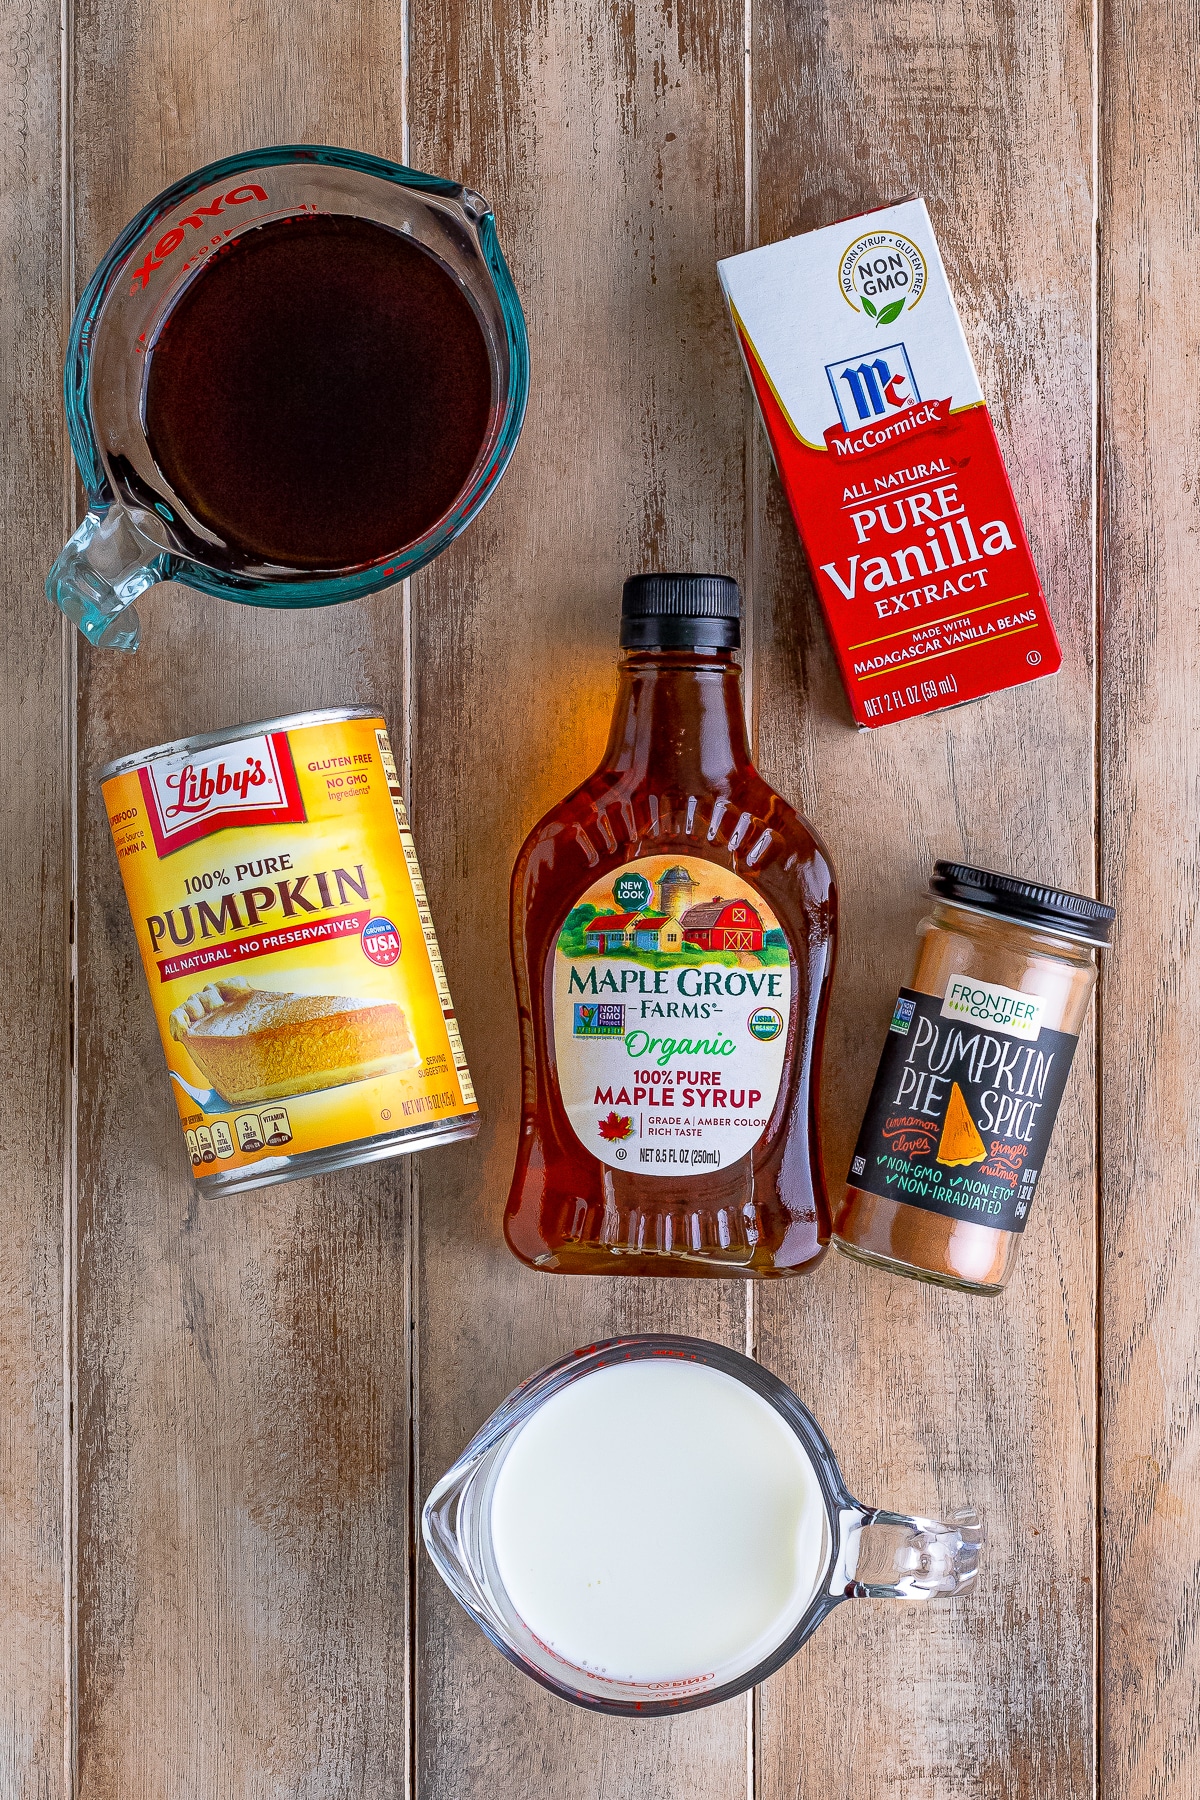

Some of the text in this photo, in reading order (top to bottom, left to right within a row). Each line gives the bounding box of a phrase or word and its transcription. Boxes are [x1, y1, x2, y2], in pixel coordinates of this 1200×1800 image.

[843, 236, 923, 295] NO CORN SYRUP GLUTEN FREE
[858, 253, 903, 280] NON
[863, 271, 908, 296] GMO
[831, 403, 941, 456] McCormick
[842, 458, 950, 502] ALL NATURAL
[850, 484, 965, 544] PURE
[820, 516, 1016, 601] Vanilla
[873, 568, 988, 619] EXTRACT
[853, 609, 1037, 674] MADAGASCAR VANILLA BEANS
[912, 618, 971, 642] MADE WITH
[864, 695, 883, 717] NET
[886, 695, 893, 710] 2
[893, 691, 906, 708] FL
[906, 685, 921, 704] OZ
[921, 681, 937, 702] (59
[308, 757, 352, 771] GLUTEN
[353, 754, 372, 764] FREE
[166, 756, 270, 818] Libby's
[326, 774, 367, 789] NO GMO
[140, 841, 147, 850] A
[184, 853, 293, 895] 100% PURE
[620, 881, 642, 890] NEW
[617, 890, 645, 899] LOOK
[146, 864, 371, 953] PUMPKIN
[365, 926, 385, 935] GROWN
[164, 917, 360, 975] ALL NATURAL NO PRESERVATIVES
[366, 934, 399, 953] USA
[568, 966, 783, 997] MAPLE GROVE
[599, 1005, 620, 1013] NON
[951, 984, 1036, 1021] FRONTIER
[970, 1006, 1011, 1025] CO-OP
[624, 1030, 736, 1066] Organic
[905, 1015, 1055, 1099] PUMPKIN
[418, 1064, 449, 1078] SUGGESTION
[426, 1054, 447, 1066] SERVING
[634, 1070, 721, 1085] 100% PURE
[402, 1099, 415, 1116] NET
[415, 1097, 425, 1113] WT
[425, 1096, 433, 1110] 15
[433, 1094, 440, 1109] OZ
[593, 1086, 762, 1109] MAPLE SYRUP
[893, 1066, 1042, 1142] PIE SPICE
[263, 1113, 284, 1124] VITAMIN
[273, 1122, 279, 1132] A
[648, 1116, 681, 1125] GRADE
[697, 1118, 731, 1126] AMBER
[733, 1118, 767, 1127] COLOR
[886, 1114, 940, 1131] cinnamon
[243, 1131, 256, 1139] FIBER
[648, 1128, 702, 1137] RICH TASTE
[892, 1134, 931, 1152] cloves
[639, 1148, 653, 1163] NET
[656, 1149, 667, 1163] 8.5
[668, 1149, 677, 1163] FL
[680, 1149, 689, 1163] OZ
[990, 1138, 1029, 1160] ginger
[887, 1157, 943, 1183] NON-GMO
[978, 1162, 1018, 1187] nutmeg
[897, 1176, 1002, 1215] NON-IRRADIATED
